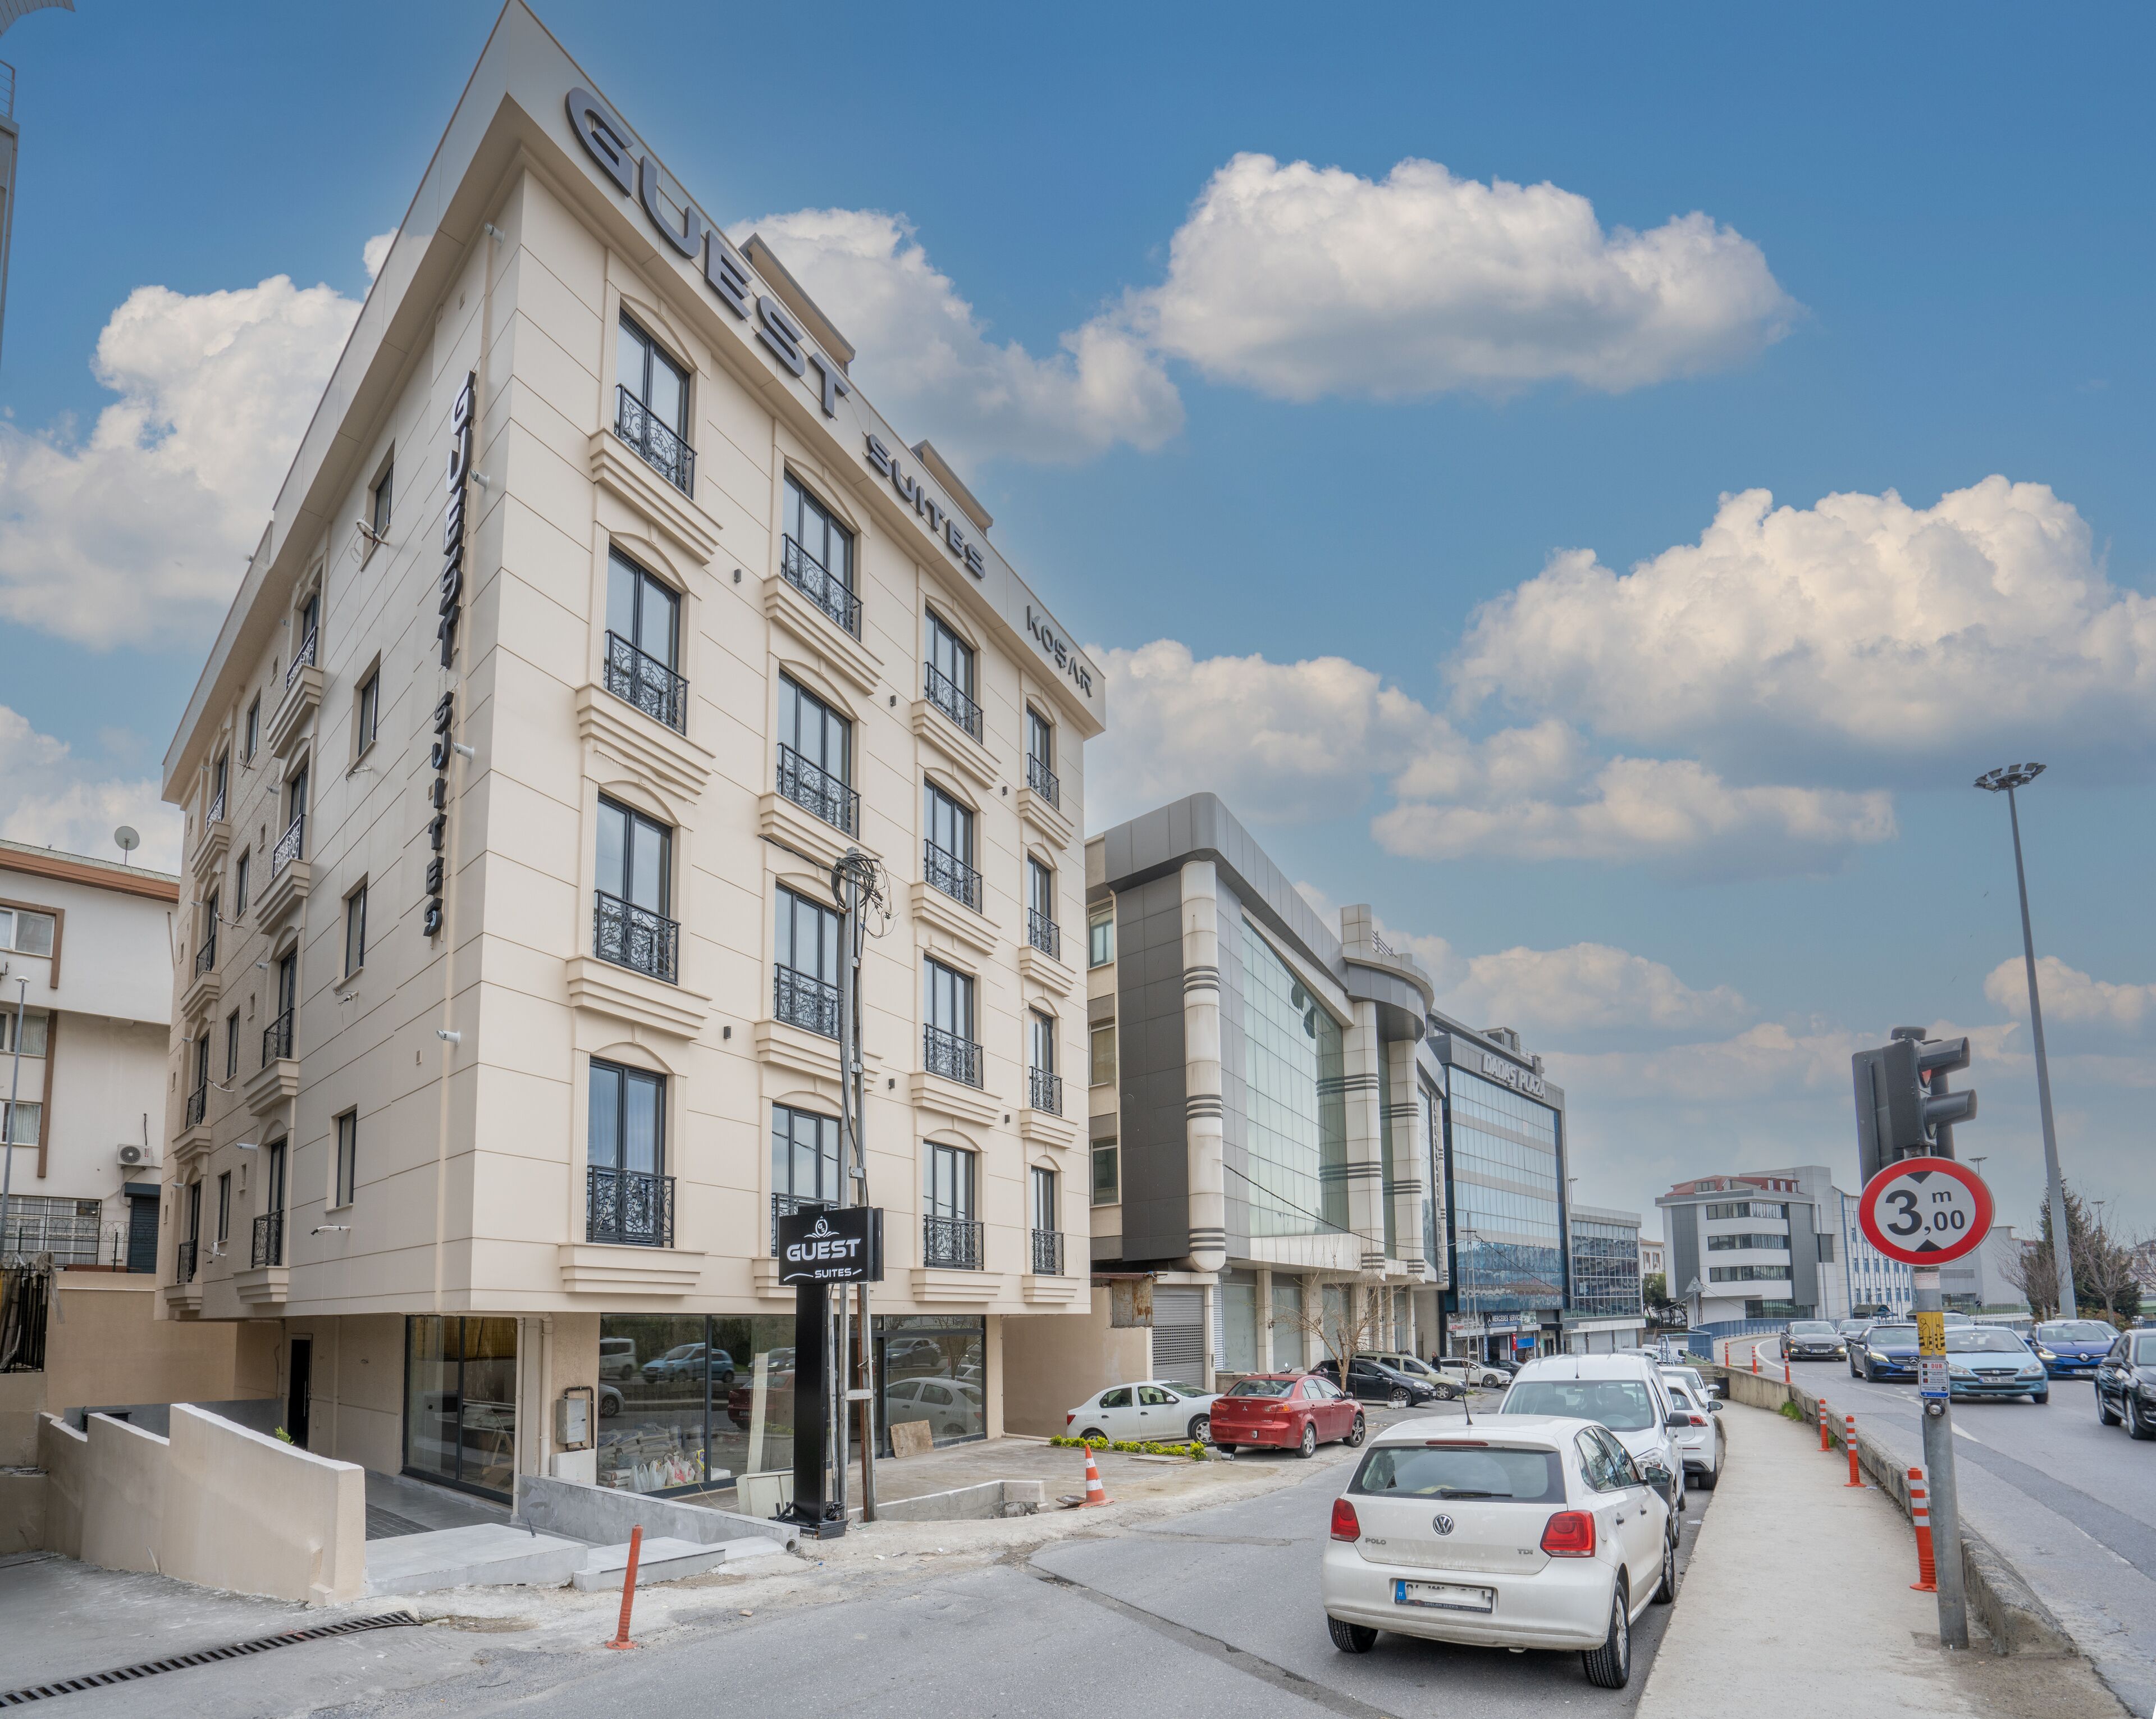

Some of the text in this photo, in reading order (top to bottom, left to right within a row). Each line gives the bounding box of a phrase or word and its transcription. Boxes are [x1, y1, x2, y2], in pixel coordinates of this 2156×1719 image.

[565, 86, 986, 580] GUEST SUITES
[423, 370, 476, 937] GUEST SUITES
[1026, 604, 1093, 697] KOŞAR
[1518, 1070, 1546, 1098] PLAZA
[1931, 1191, 1952, 1203] m
[786, 1238, 861, 1261] GUEST
[815, 1267, 852, 1279] SUITES
